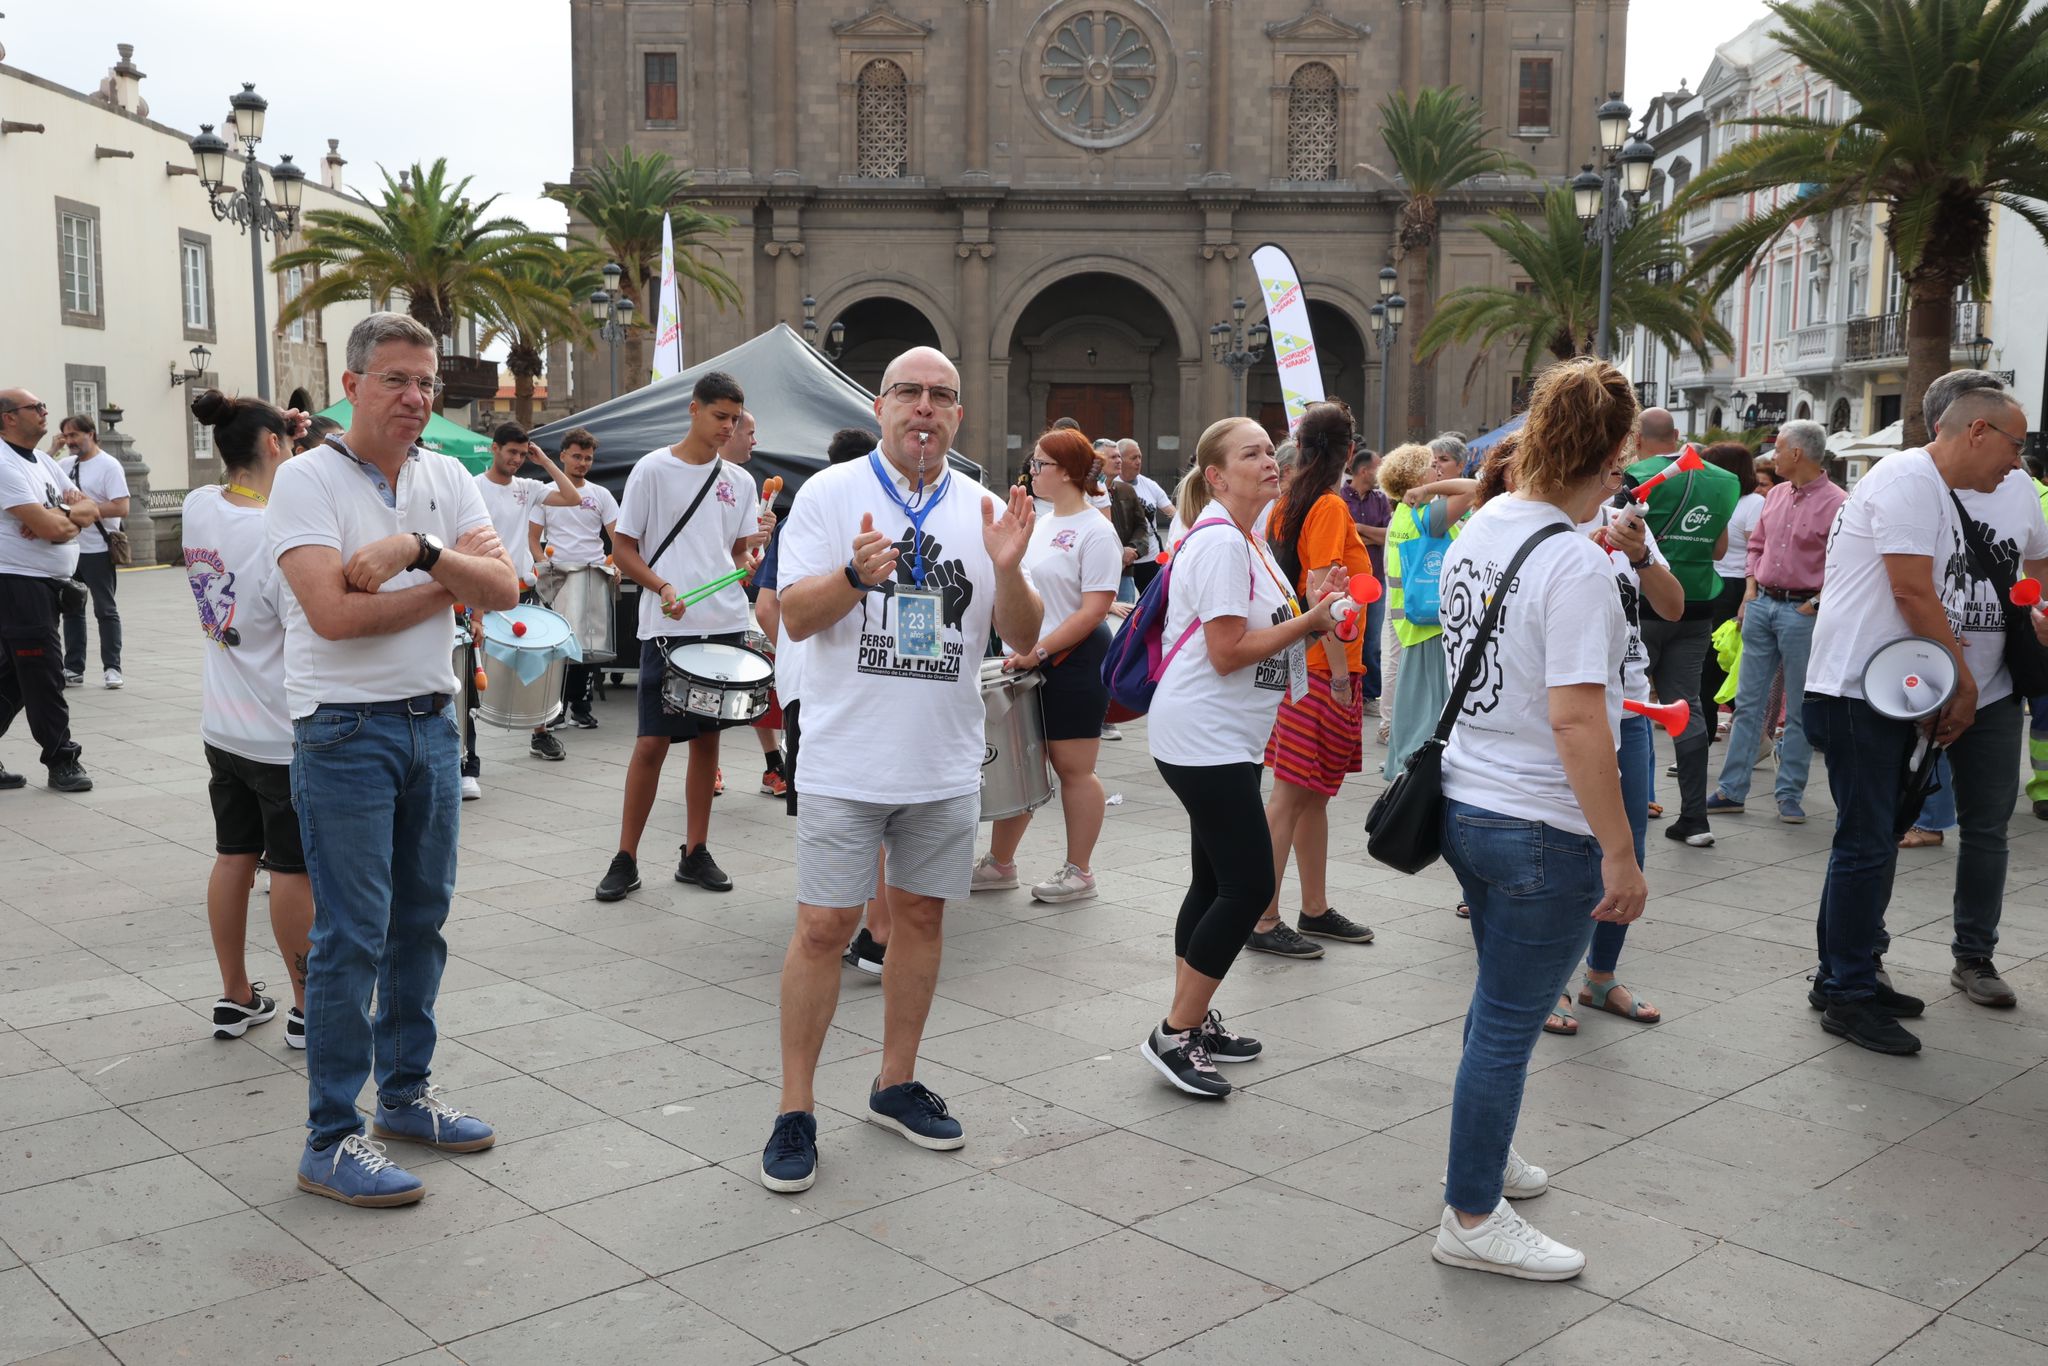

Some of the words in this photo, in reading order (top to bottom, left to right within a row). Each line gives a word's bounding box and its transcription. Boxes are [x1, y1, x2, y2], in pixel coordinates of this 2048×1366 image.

[1482, 560, 1520, 594] fijea
[1985, 603, 1996, 612] EN
[908, 613, 925, 630] 23
[1965, 612, 1980, 626] LA
[860, 634, 896, 649] PERSO
[858, 647, 888, 668] POR
[1255, 667, 1276, 683] POR
